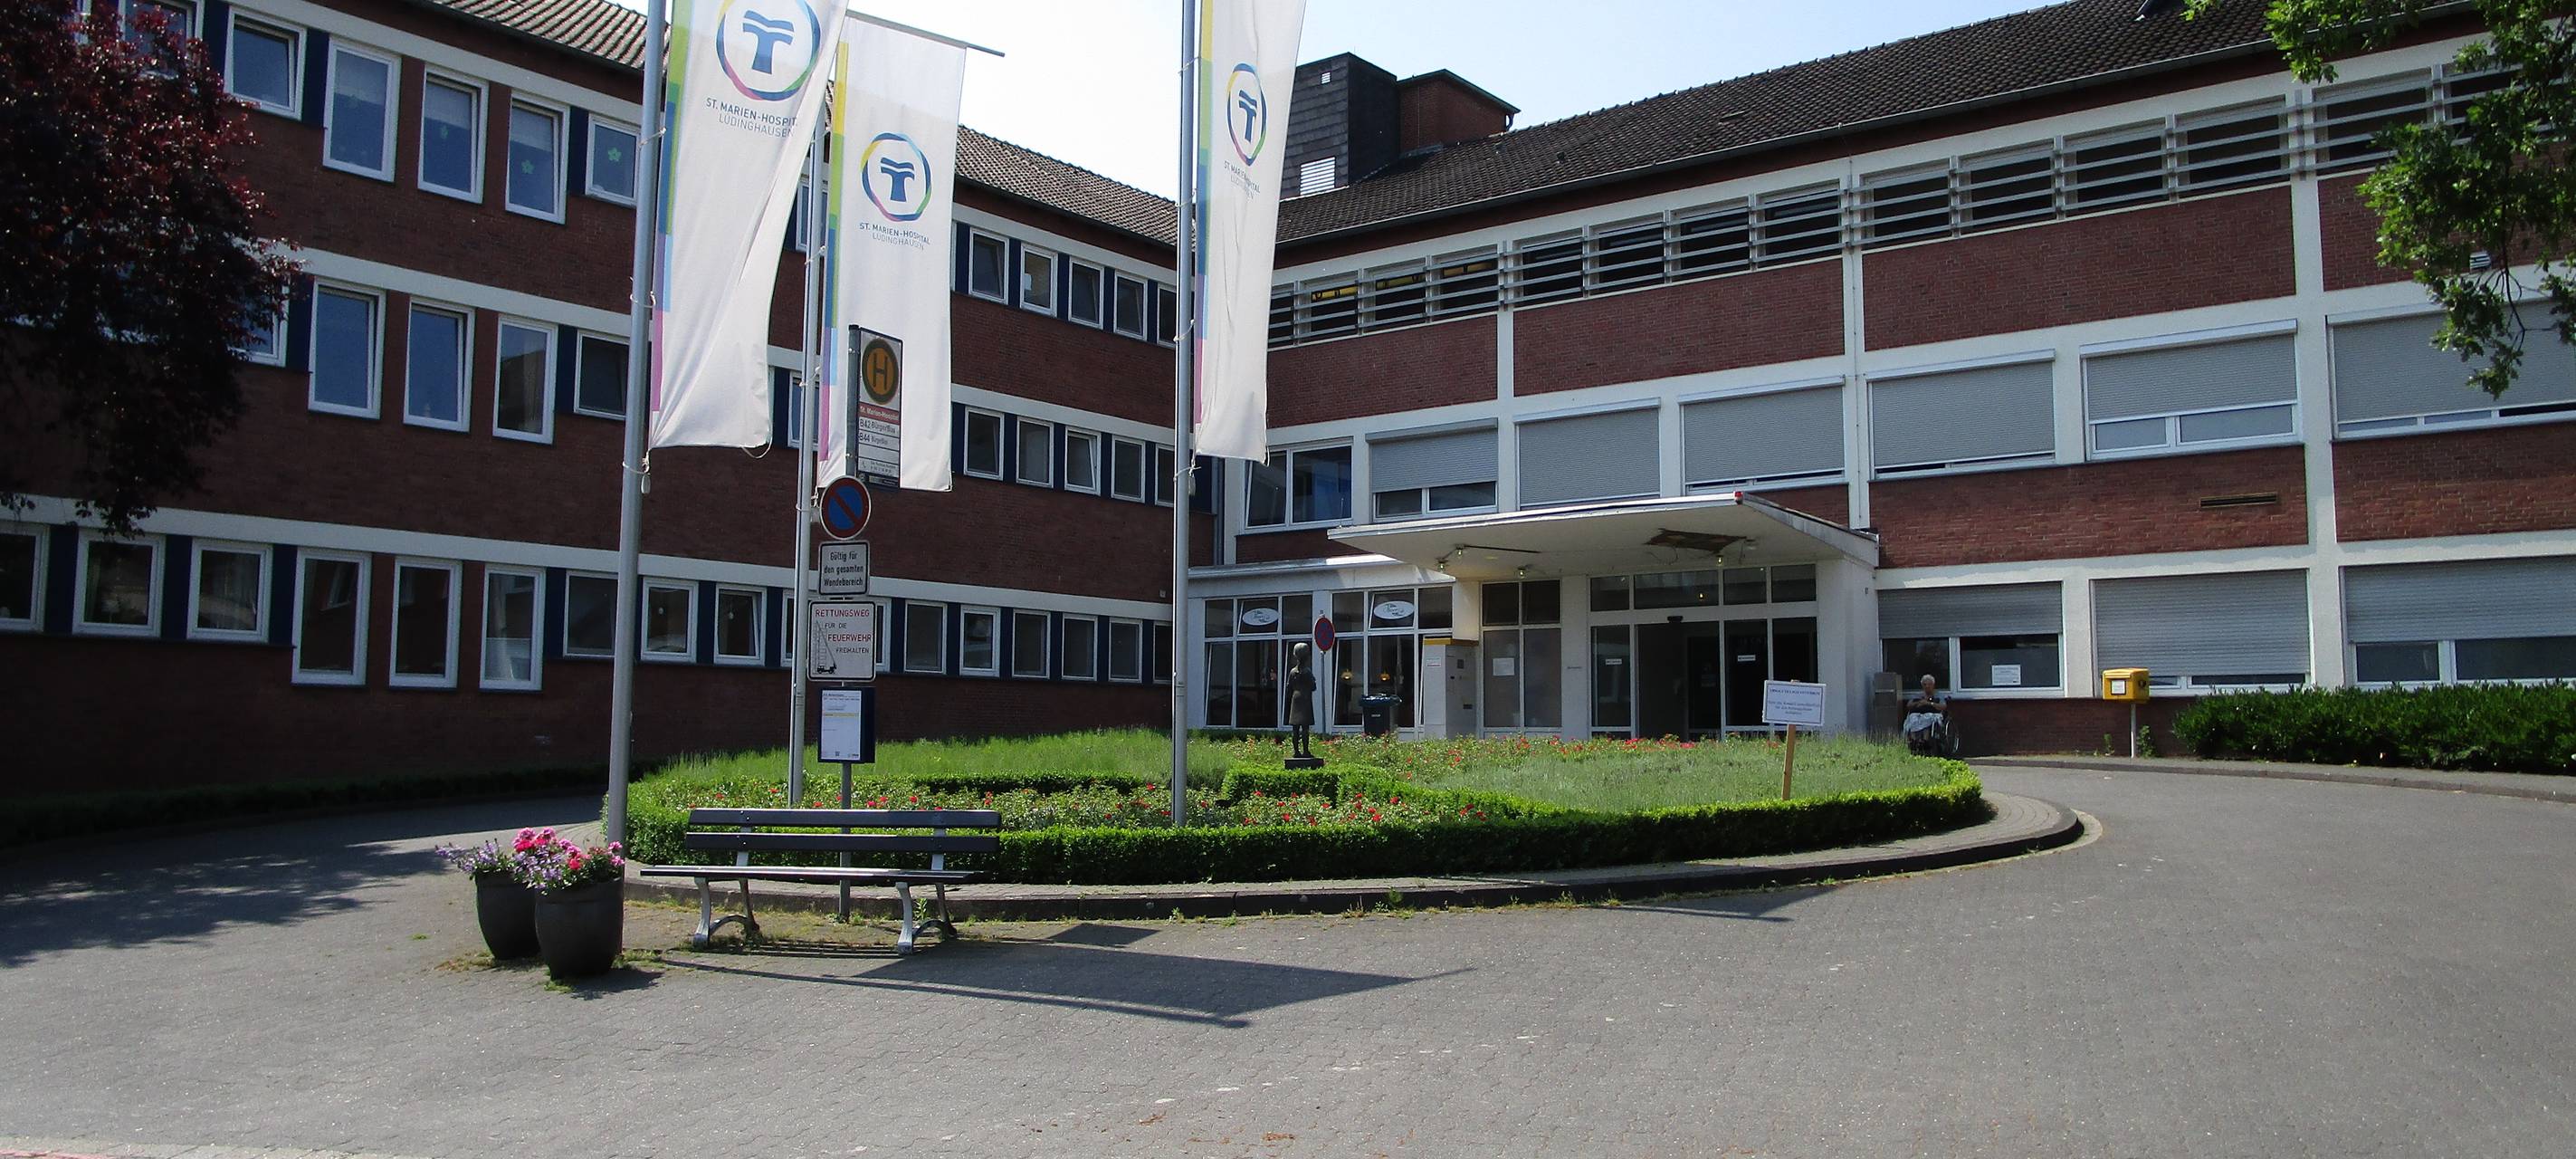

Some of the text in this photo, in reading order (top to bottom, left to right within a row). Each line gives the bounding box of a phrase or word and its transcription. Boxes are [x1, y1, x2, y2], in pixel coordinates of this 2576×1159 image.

[706, 97, 718, 110] ST.
[859, 222, 870, 231] ST.
[873, 352, 888, 391] H
[830, 551, 858, 562] Gültig für
[824, 565, 863, 575] den gesamten
[824, 578, 863, 587] Wendebereich
[827, 634, 872, 642] FEUERWEHR
